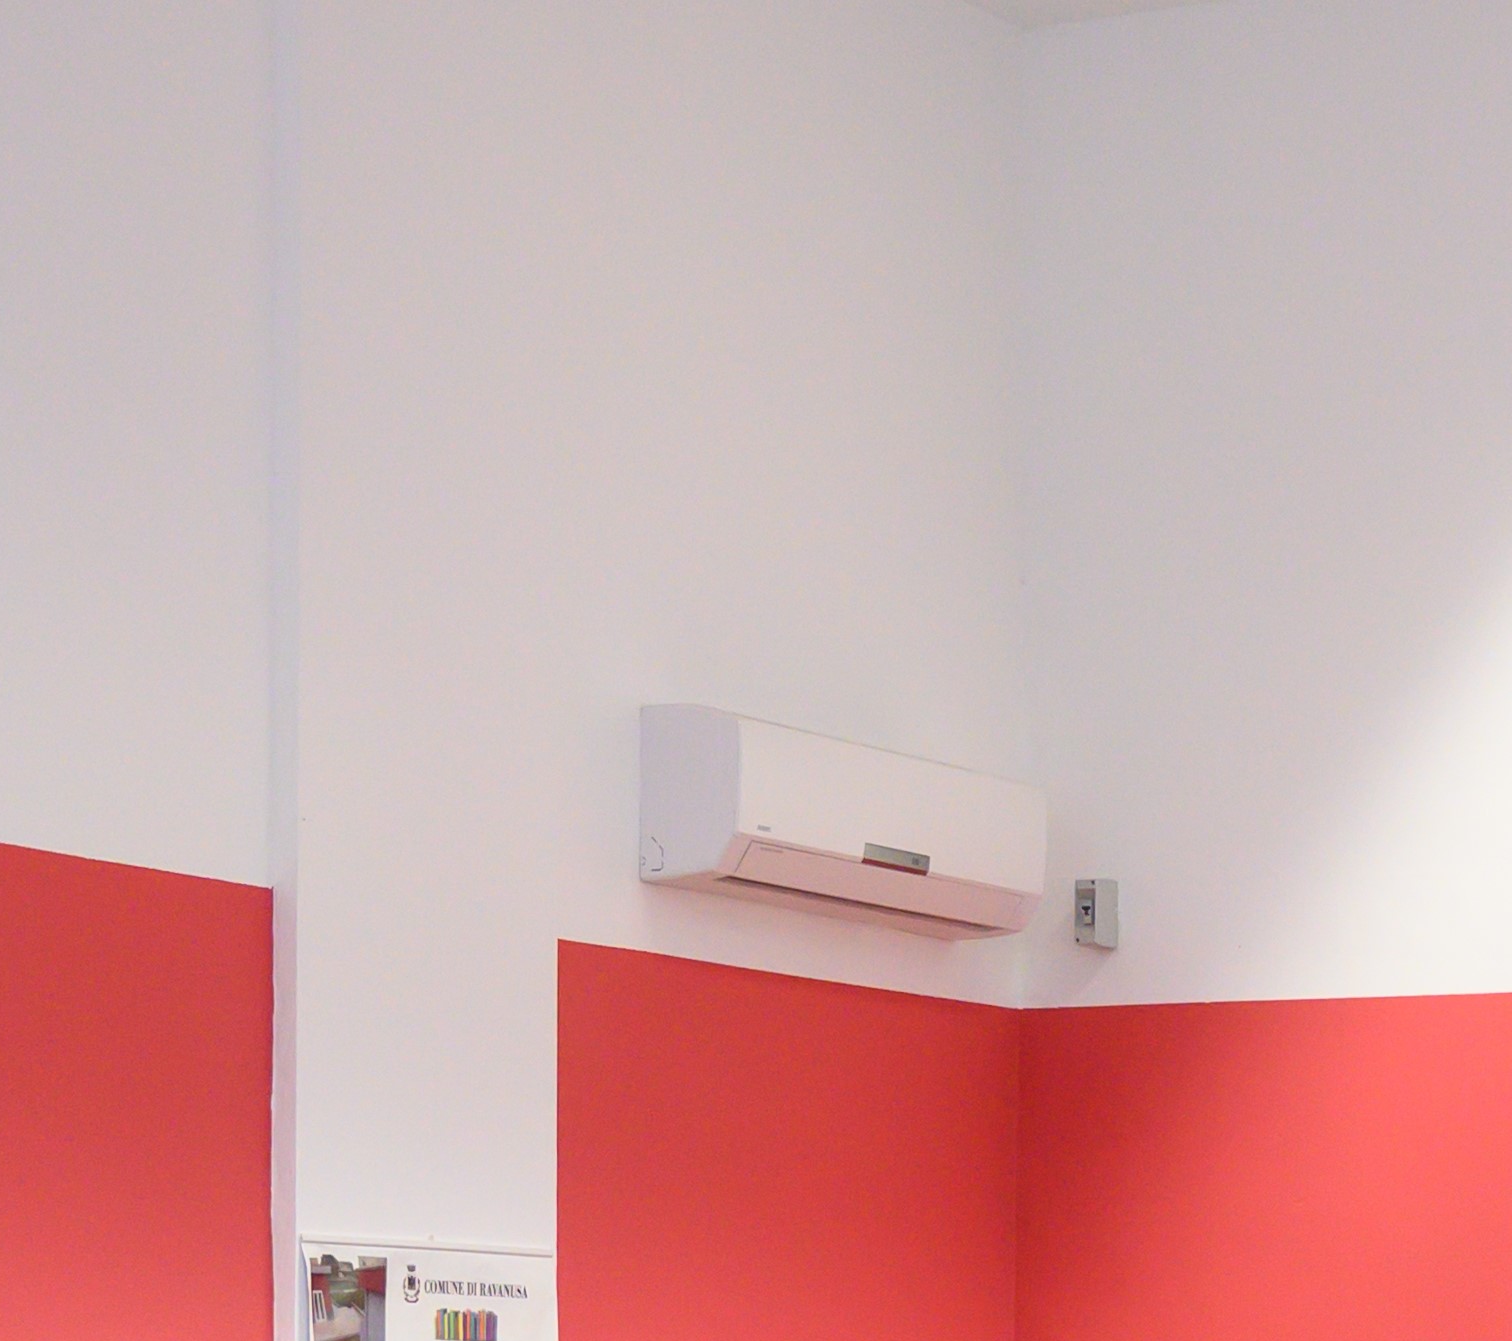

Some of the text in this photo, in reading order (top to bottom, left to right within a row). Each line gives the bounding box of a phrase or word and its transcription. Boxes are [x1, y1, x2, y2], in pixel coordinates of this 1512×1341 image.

[424, 1279, 528, 1299] COMUNE DI RAVANUSA
